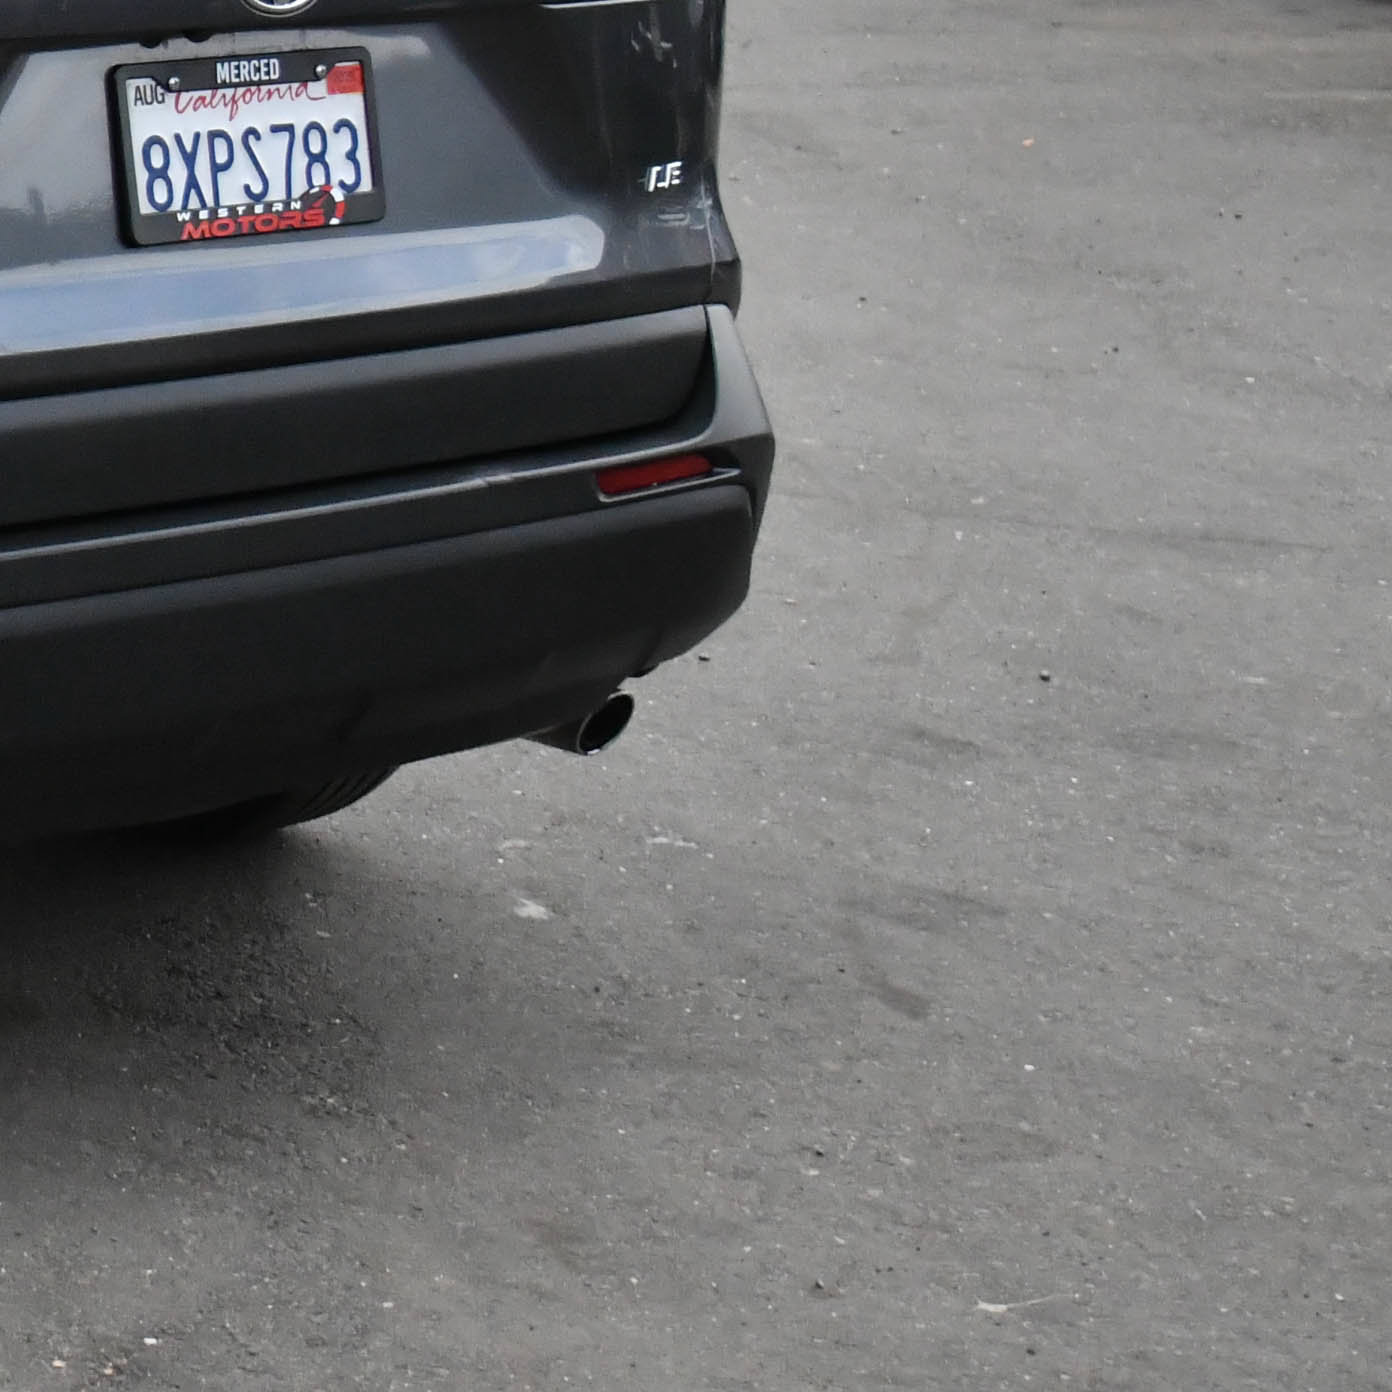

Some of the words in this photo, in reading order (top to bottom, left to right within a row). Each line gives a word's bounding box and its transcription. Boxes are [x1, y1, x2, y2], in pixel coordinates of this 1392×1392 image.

[216, 58, 280, 84] MERCED
[134, 83, 166, 106] AUG
[173, 82, 327, 121] California
[141, 118, 362, 213] 8XPS783
[646, 161, 682, 192] LE
[177, 200, 301, 222] WESTERN
[180, 207, 326, 241] MOTORS
